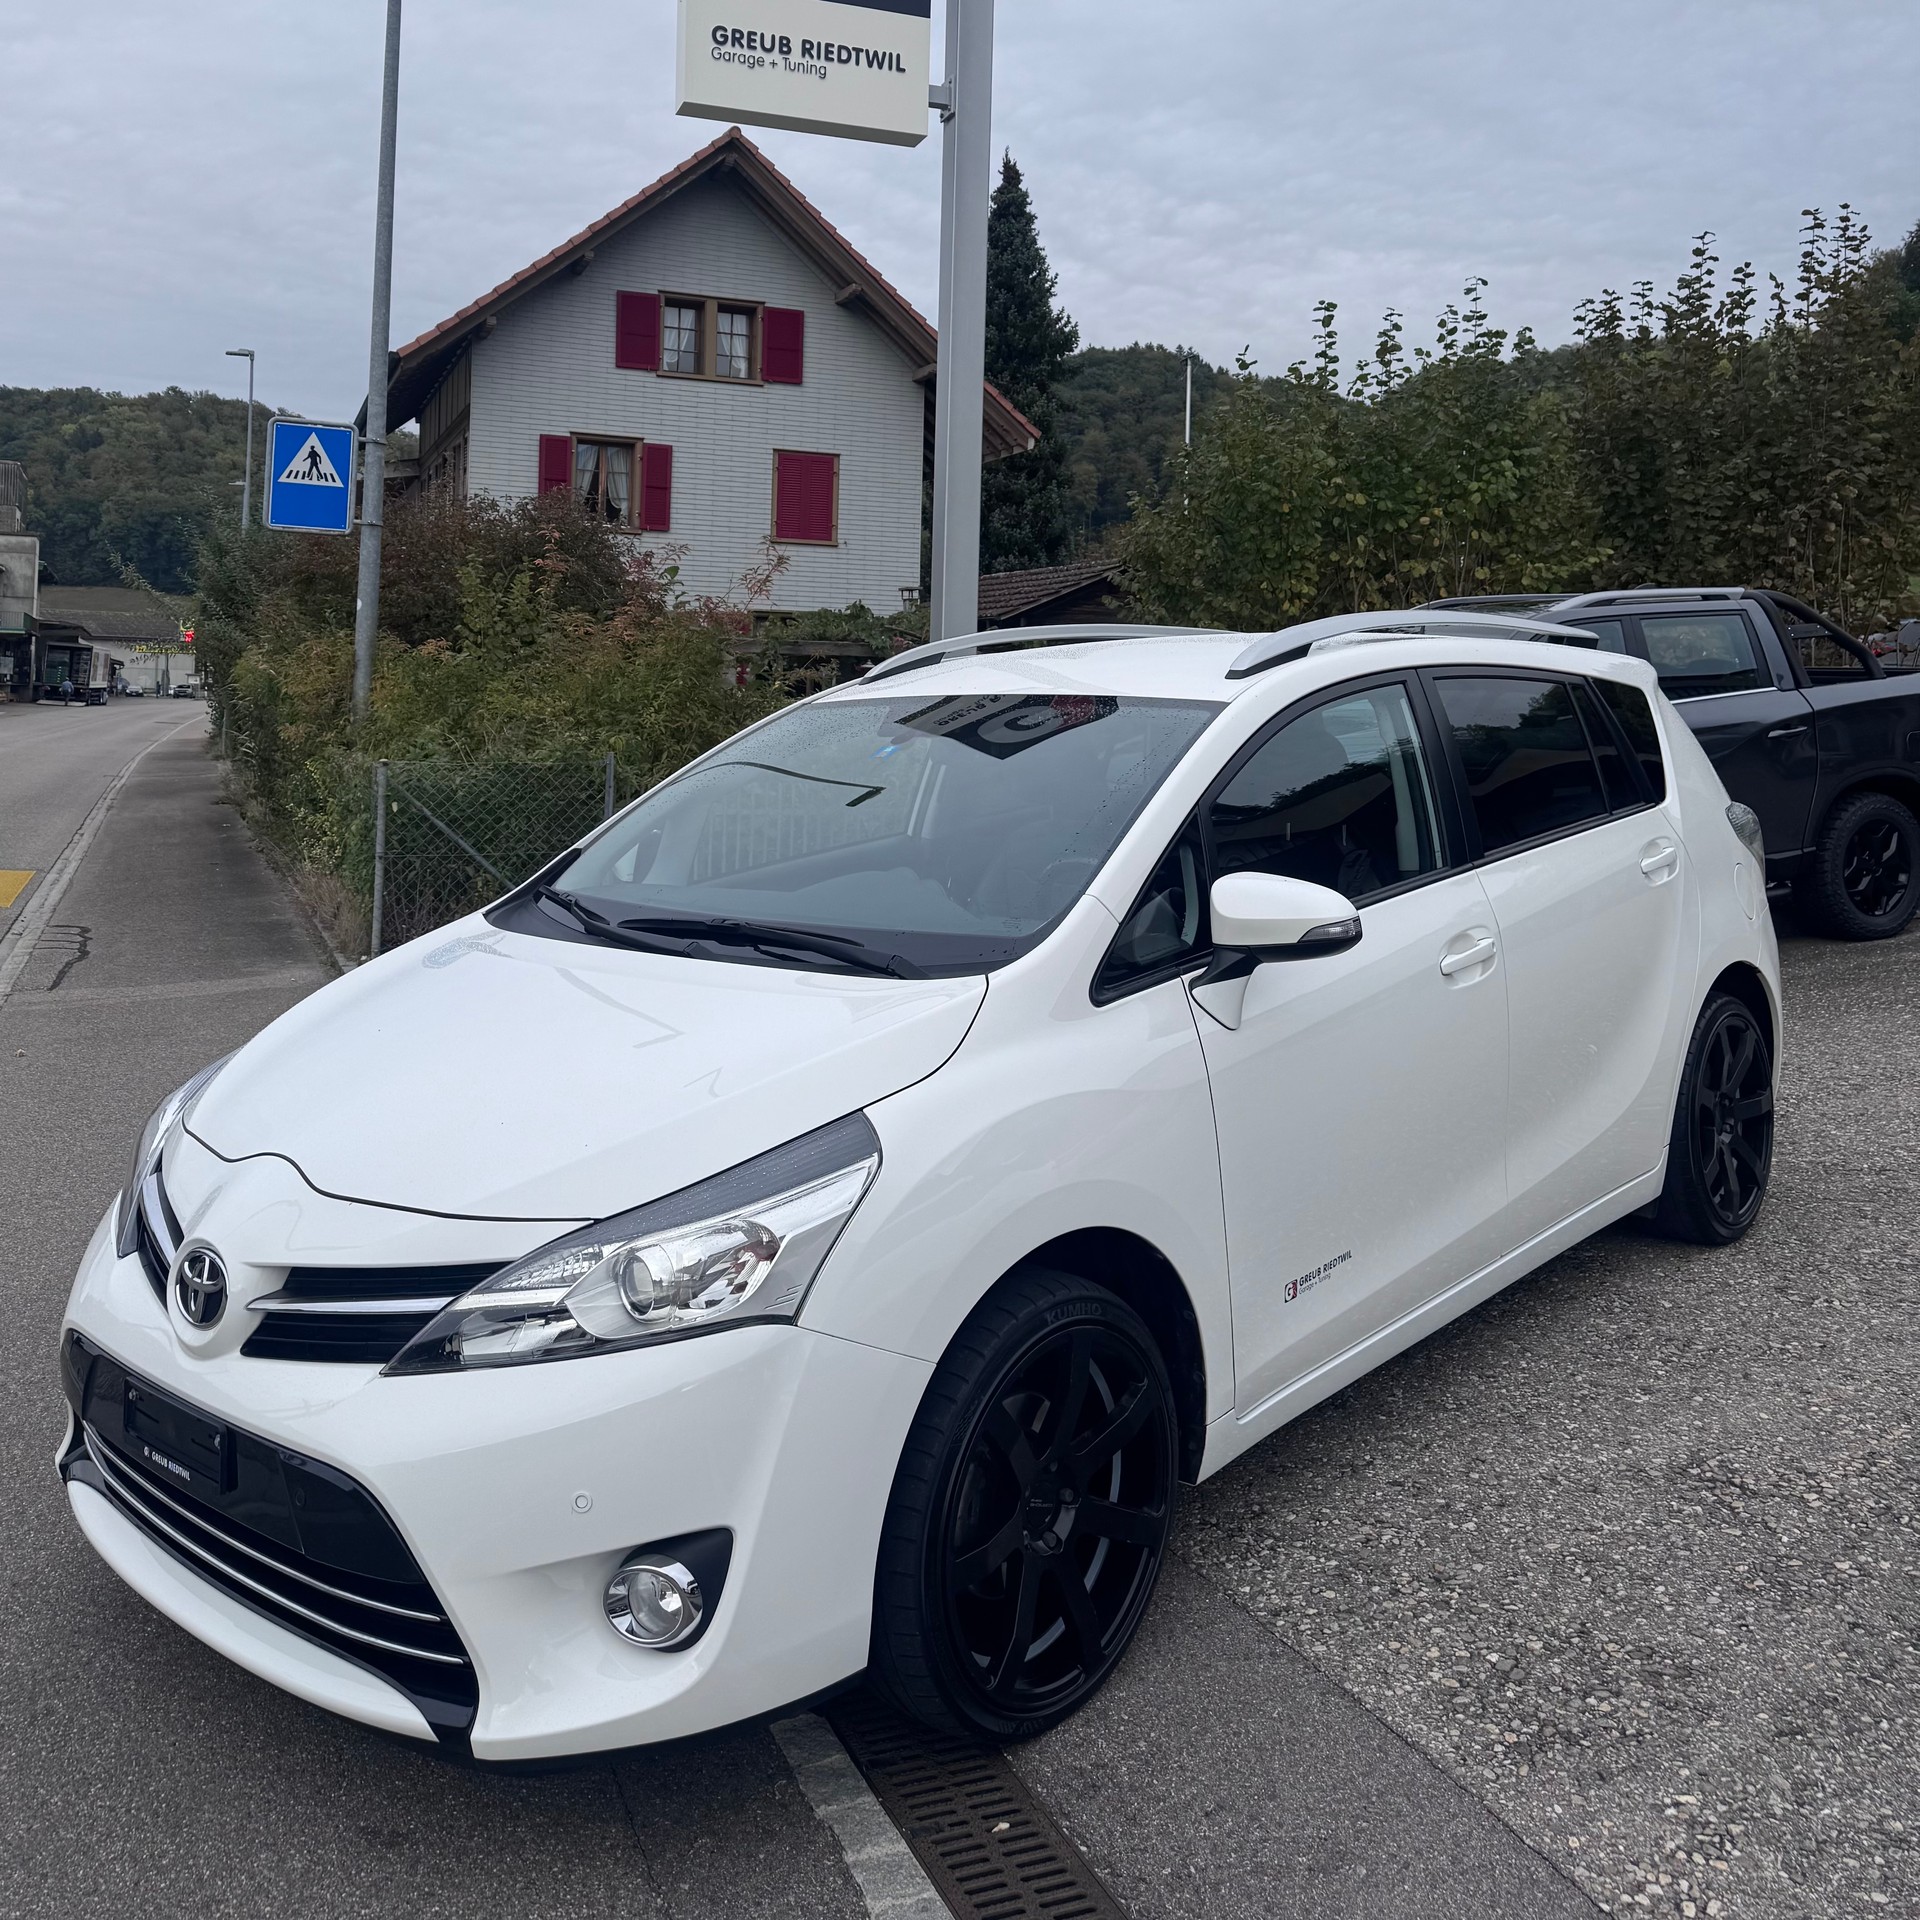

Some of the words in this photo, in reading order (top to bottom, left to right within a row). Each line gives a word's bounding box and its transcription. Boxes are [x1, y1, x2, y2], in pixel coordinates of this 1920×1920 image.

[711, 25, 792, 55] GREUB
[801, 38, 906, 73] RIEDTWIL
[711, 46, 765, 69] Garage
[769, 59, 778, 69] +
[782, 57, 827, 79] Tuning
[1299, 1267, 1321, 1287] GREUB
[1323, 1250, 1352, 1273] RIEDTWIL
[1047, 1303, 1103, 1325] KUMHO
[152, 1451, 168, 1468] GREUB
[168, 1460, 191, 1481] RIEDTWIL
